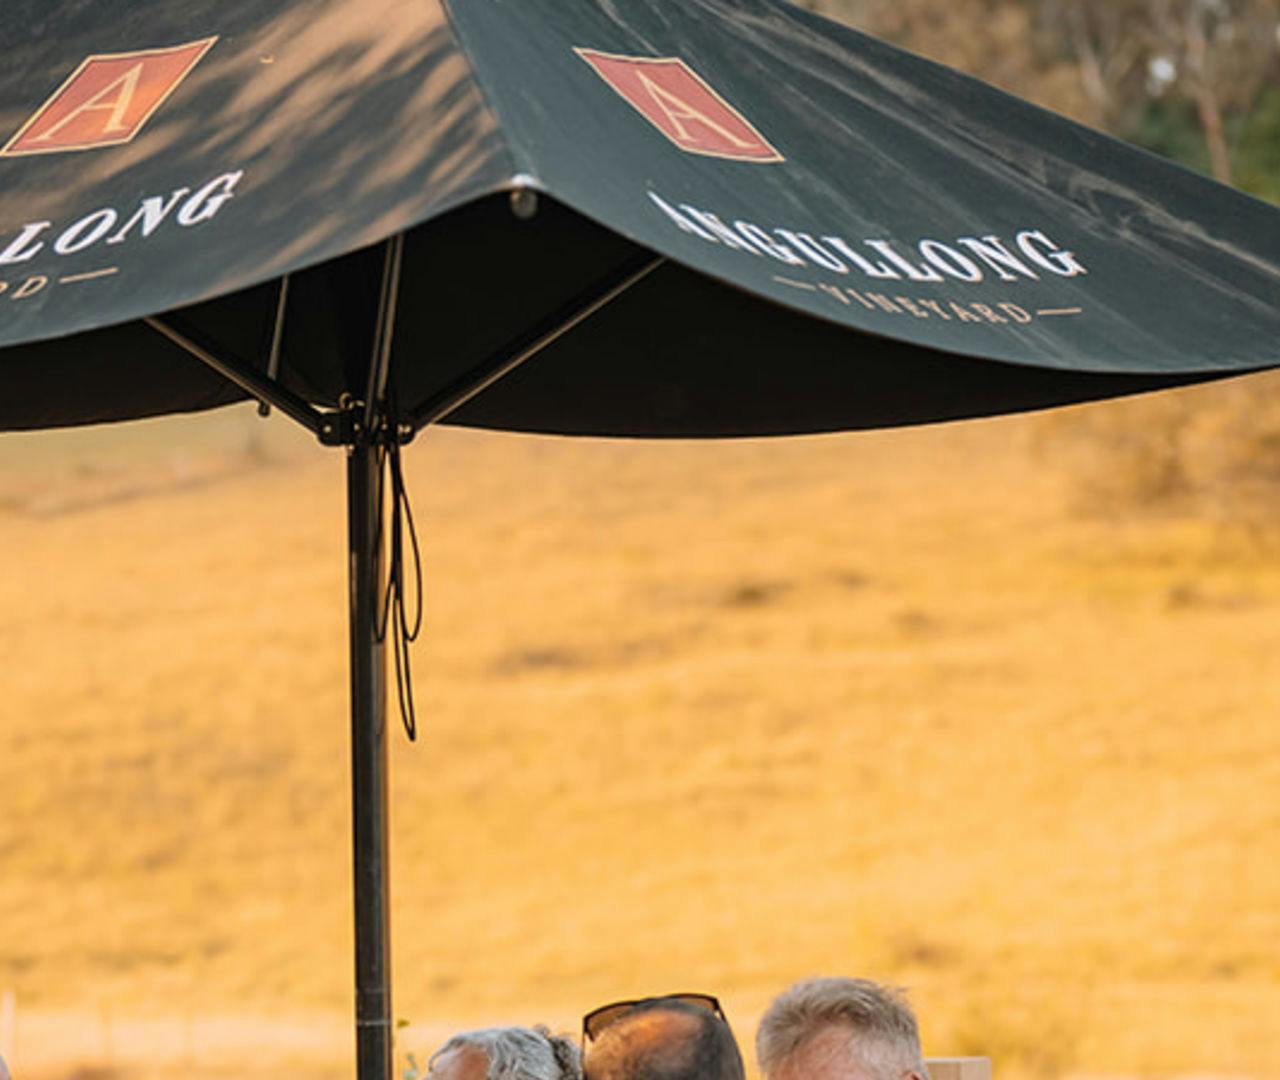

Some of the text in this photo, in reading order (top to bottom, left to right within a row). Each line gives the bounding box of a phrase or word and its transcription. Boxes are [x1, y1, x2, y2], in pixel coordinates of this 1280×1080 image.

[35, 62, 144, 141] A
[635, 69, 759, 149] A
[646, 190, 1088, 283] ANGULLONG
[817, 281, 1032, 324] VINEYARD
